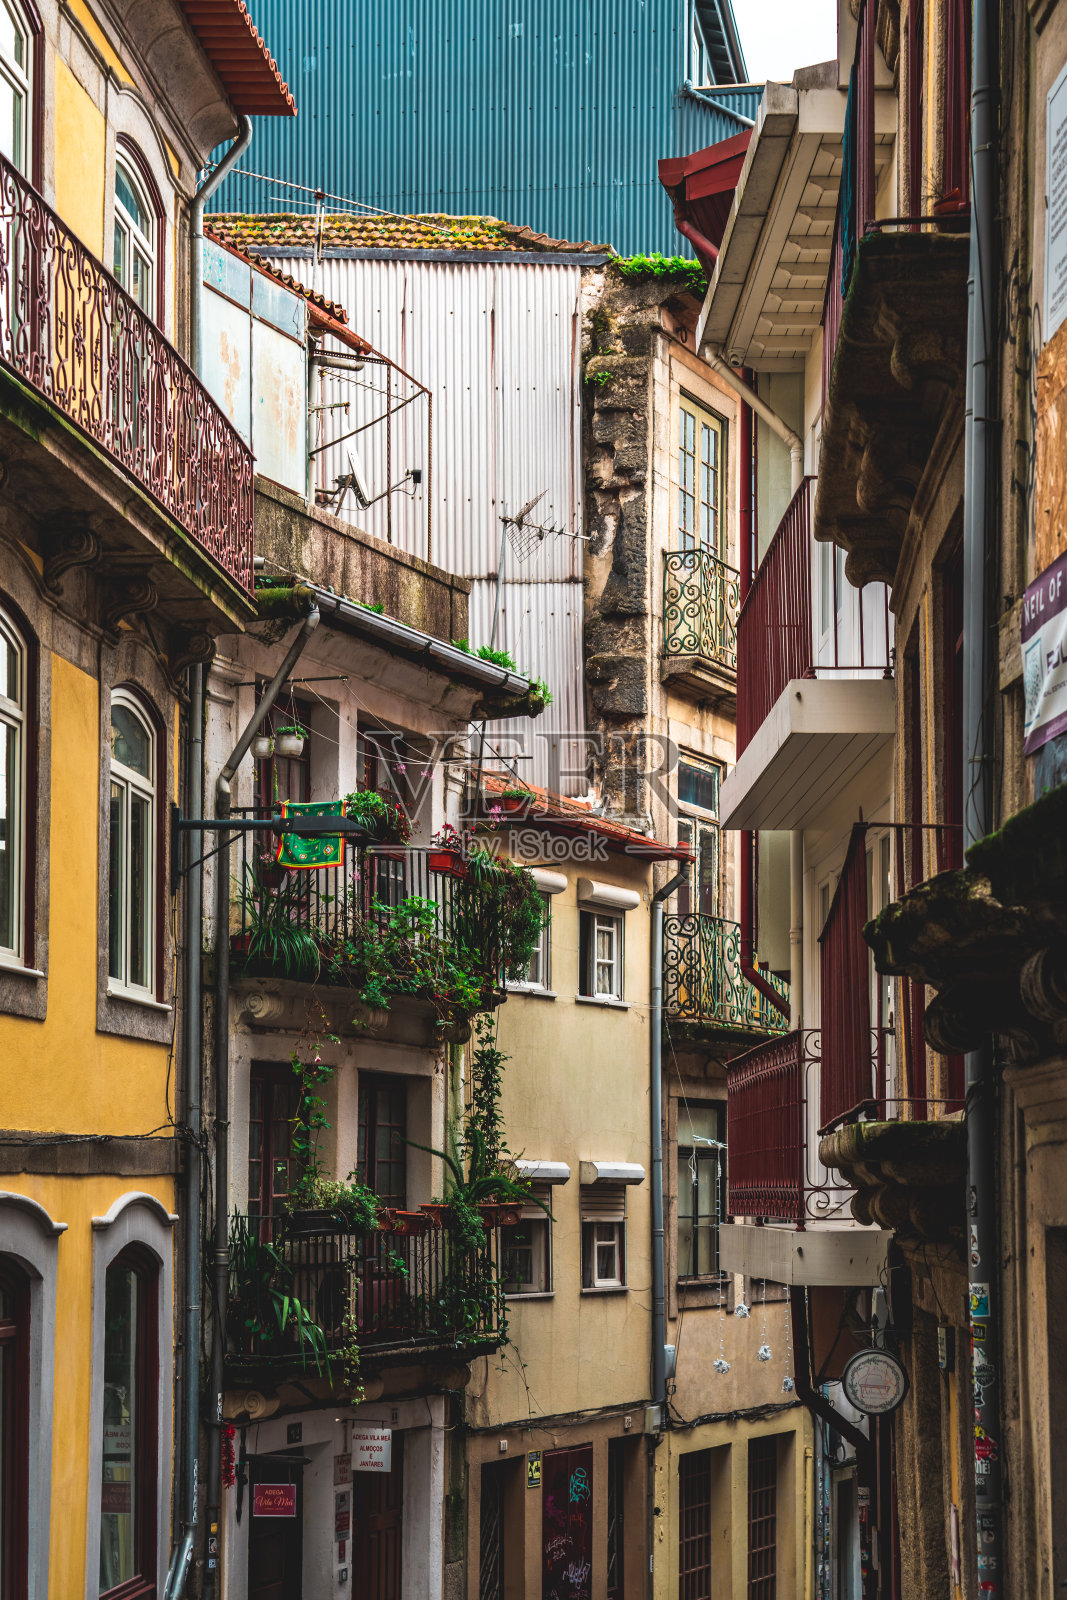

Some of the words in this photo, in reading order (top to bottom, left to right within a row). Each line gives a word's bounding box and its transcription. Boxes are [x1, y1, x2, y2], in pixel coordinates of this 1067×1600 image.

[1049, 570, 1063, 603] OF
[359, 1445, 383, 1453] ALMOÇOS
[359, 1460, 384, 1468] JANTARES
